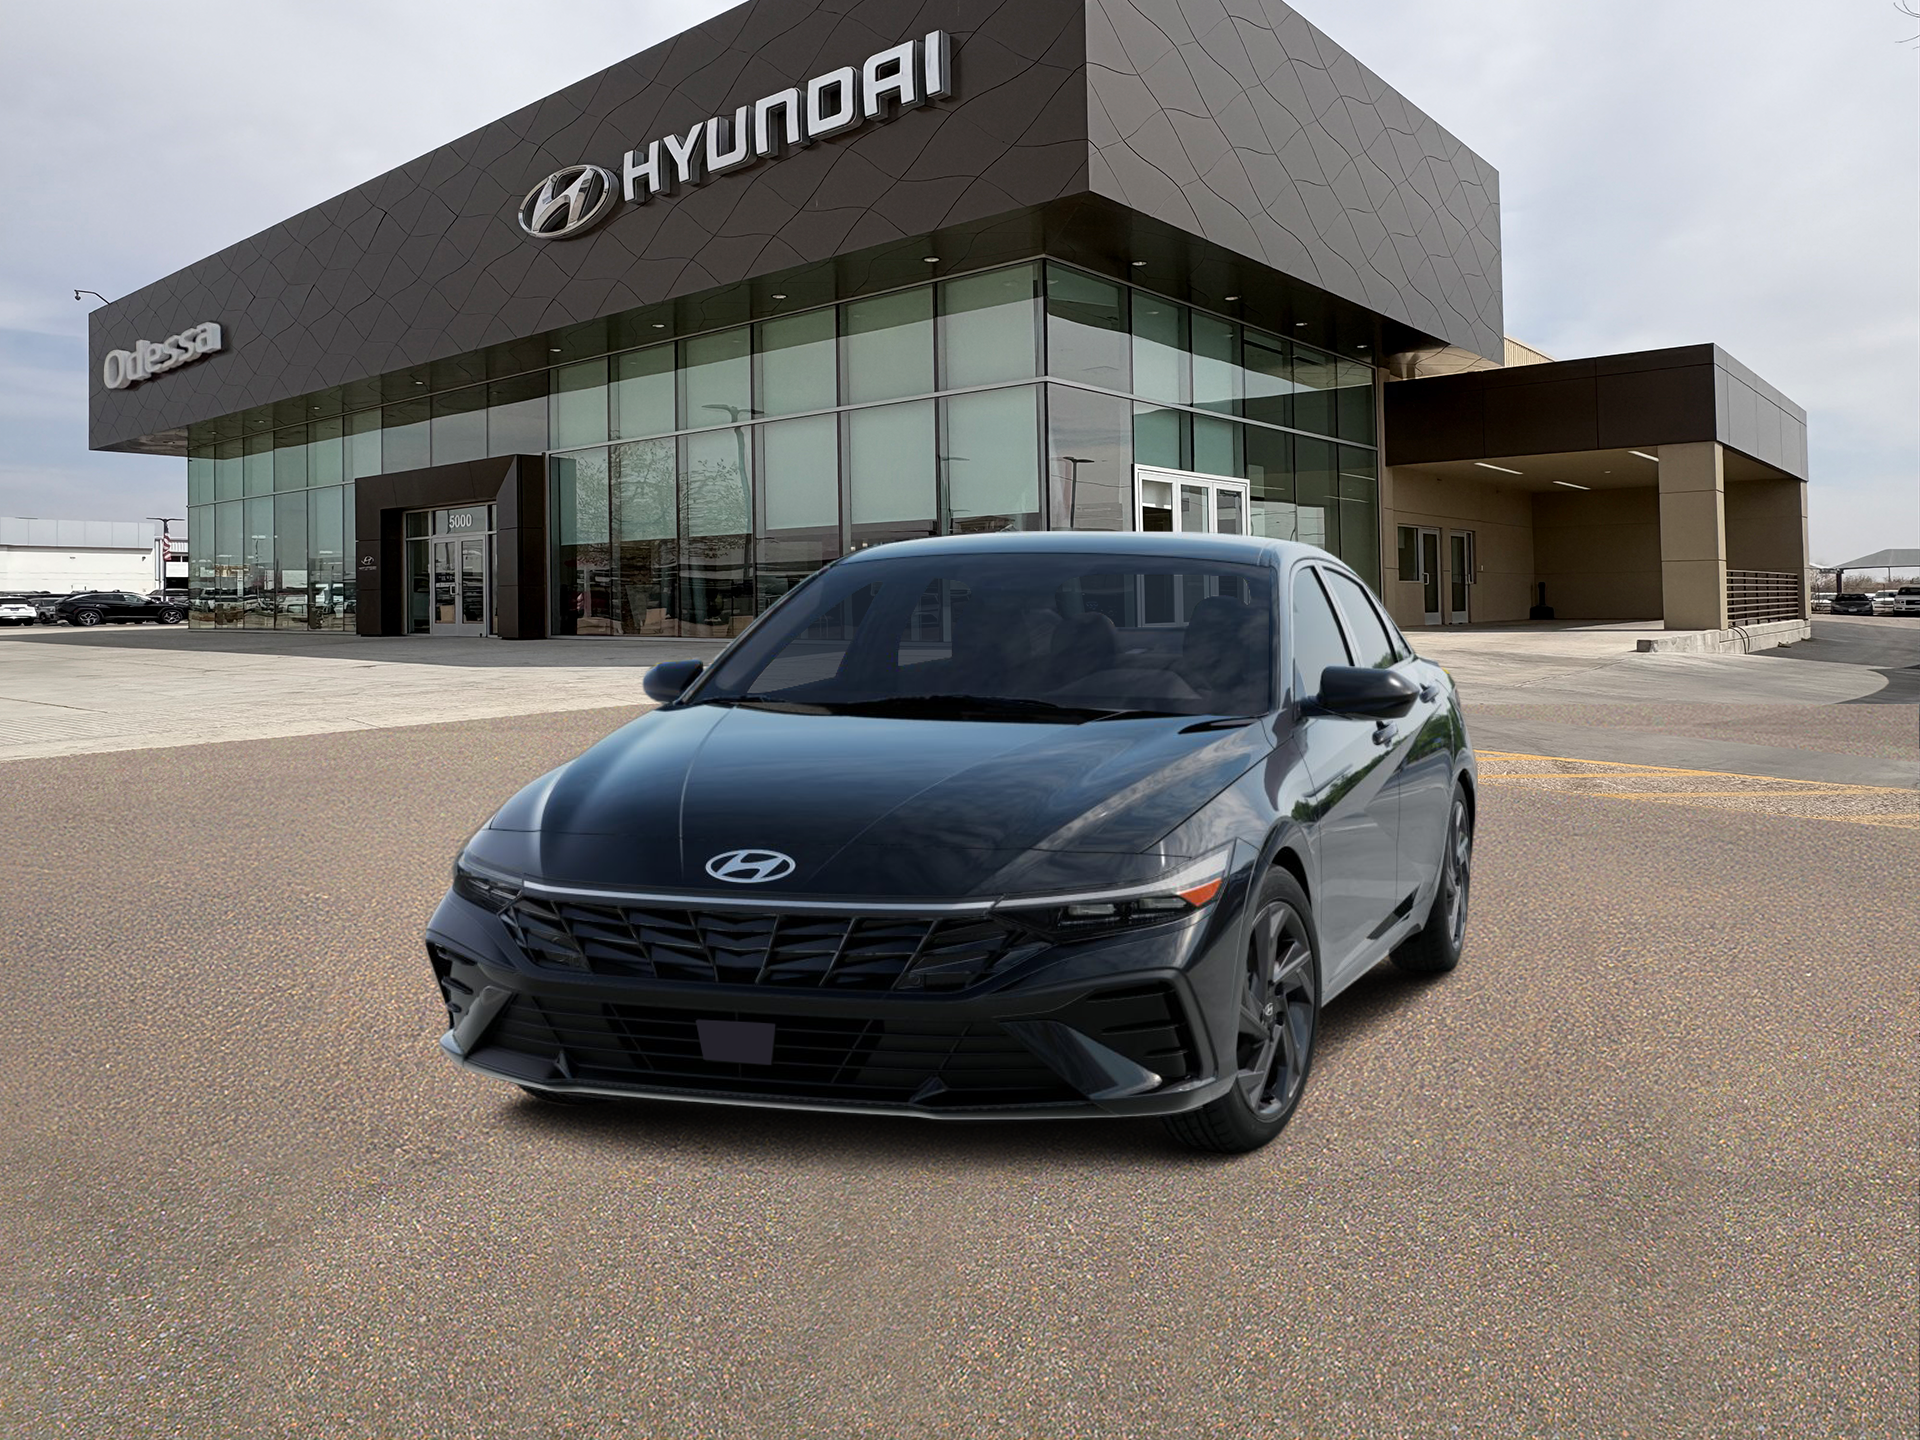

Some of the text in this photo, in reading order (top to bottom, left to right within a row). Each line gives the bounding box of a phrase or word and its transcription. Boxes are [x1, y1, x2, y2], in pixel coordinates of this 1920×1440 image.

[622, 29, 951, 203] HYUNDAI
[103, 321, 221, 389] Odessa
[449, 513, 472, 528] 5000
